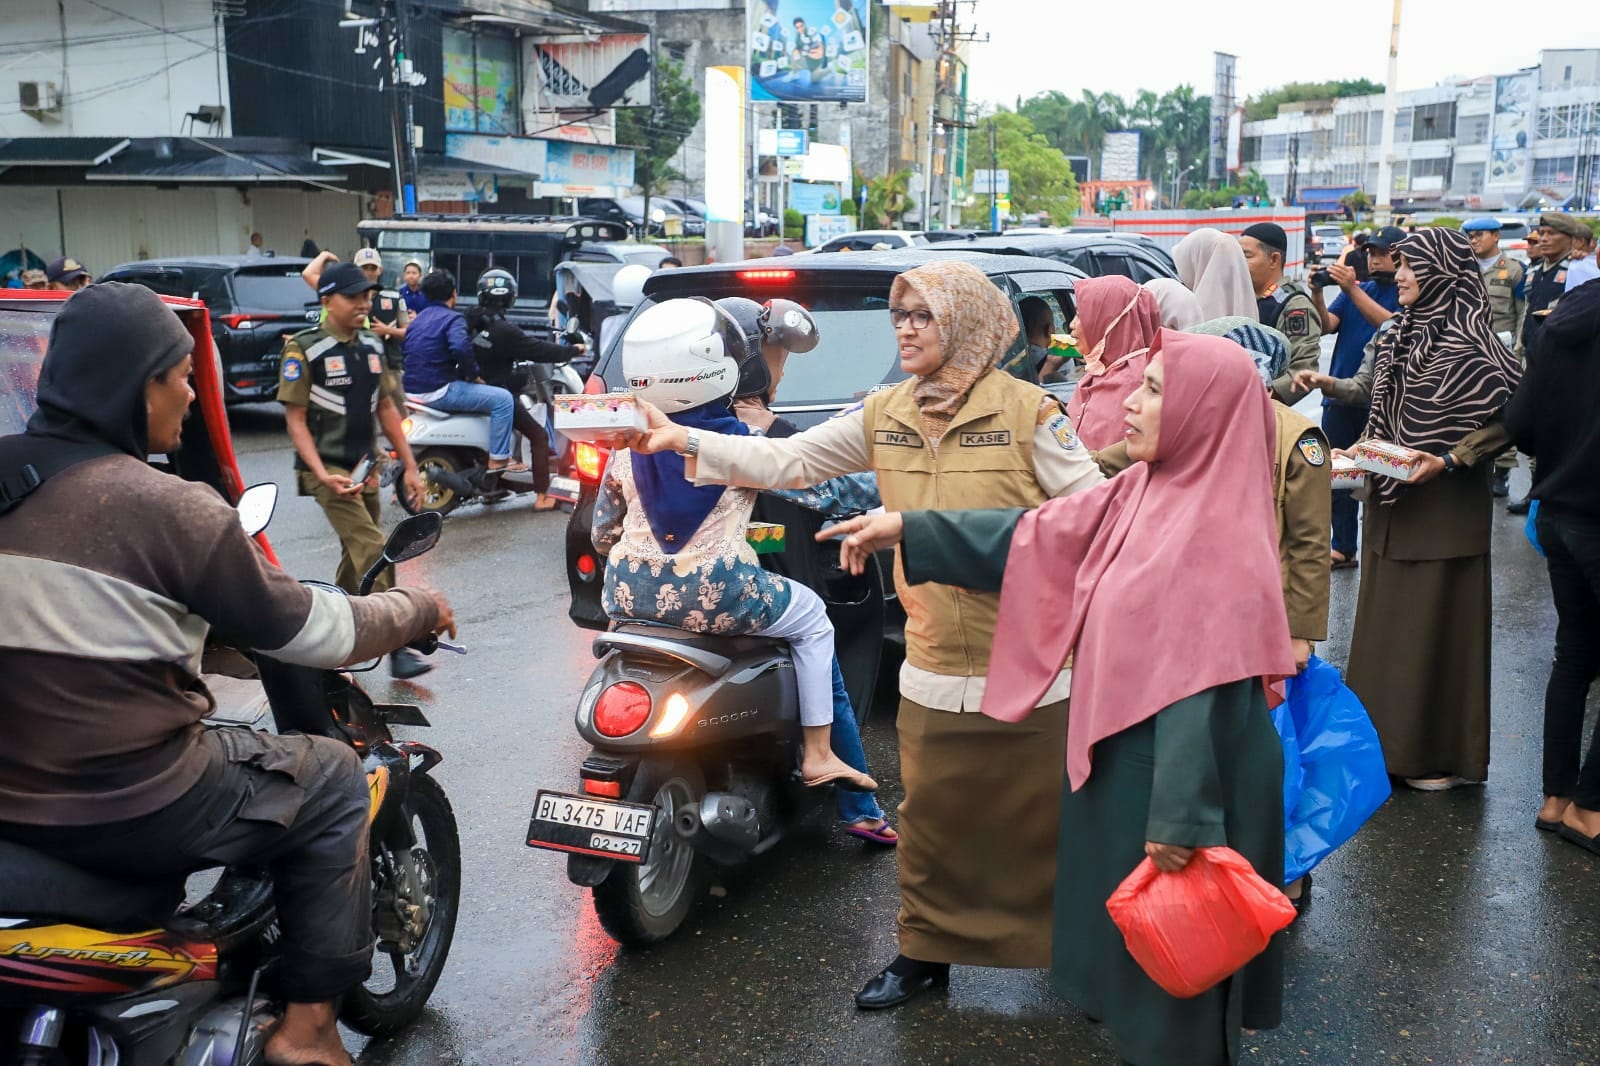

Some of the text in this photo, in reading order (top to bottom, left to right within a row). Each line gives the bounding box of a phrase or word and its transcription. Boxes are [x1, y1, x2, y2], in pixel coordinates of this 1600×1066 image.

[631, 379, 648, 387] GM
[886, 433, 909, 444] INA
[965, 433, 1005, 444] KASIE
[697, 707, 758, 727] SCOOPY
[540, 800, 647, 833] BL 3475 VAF
